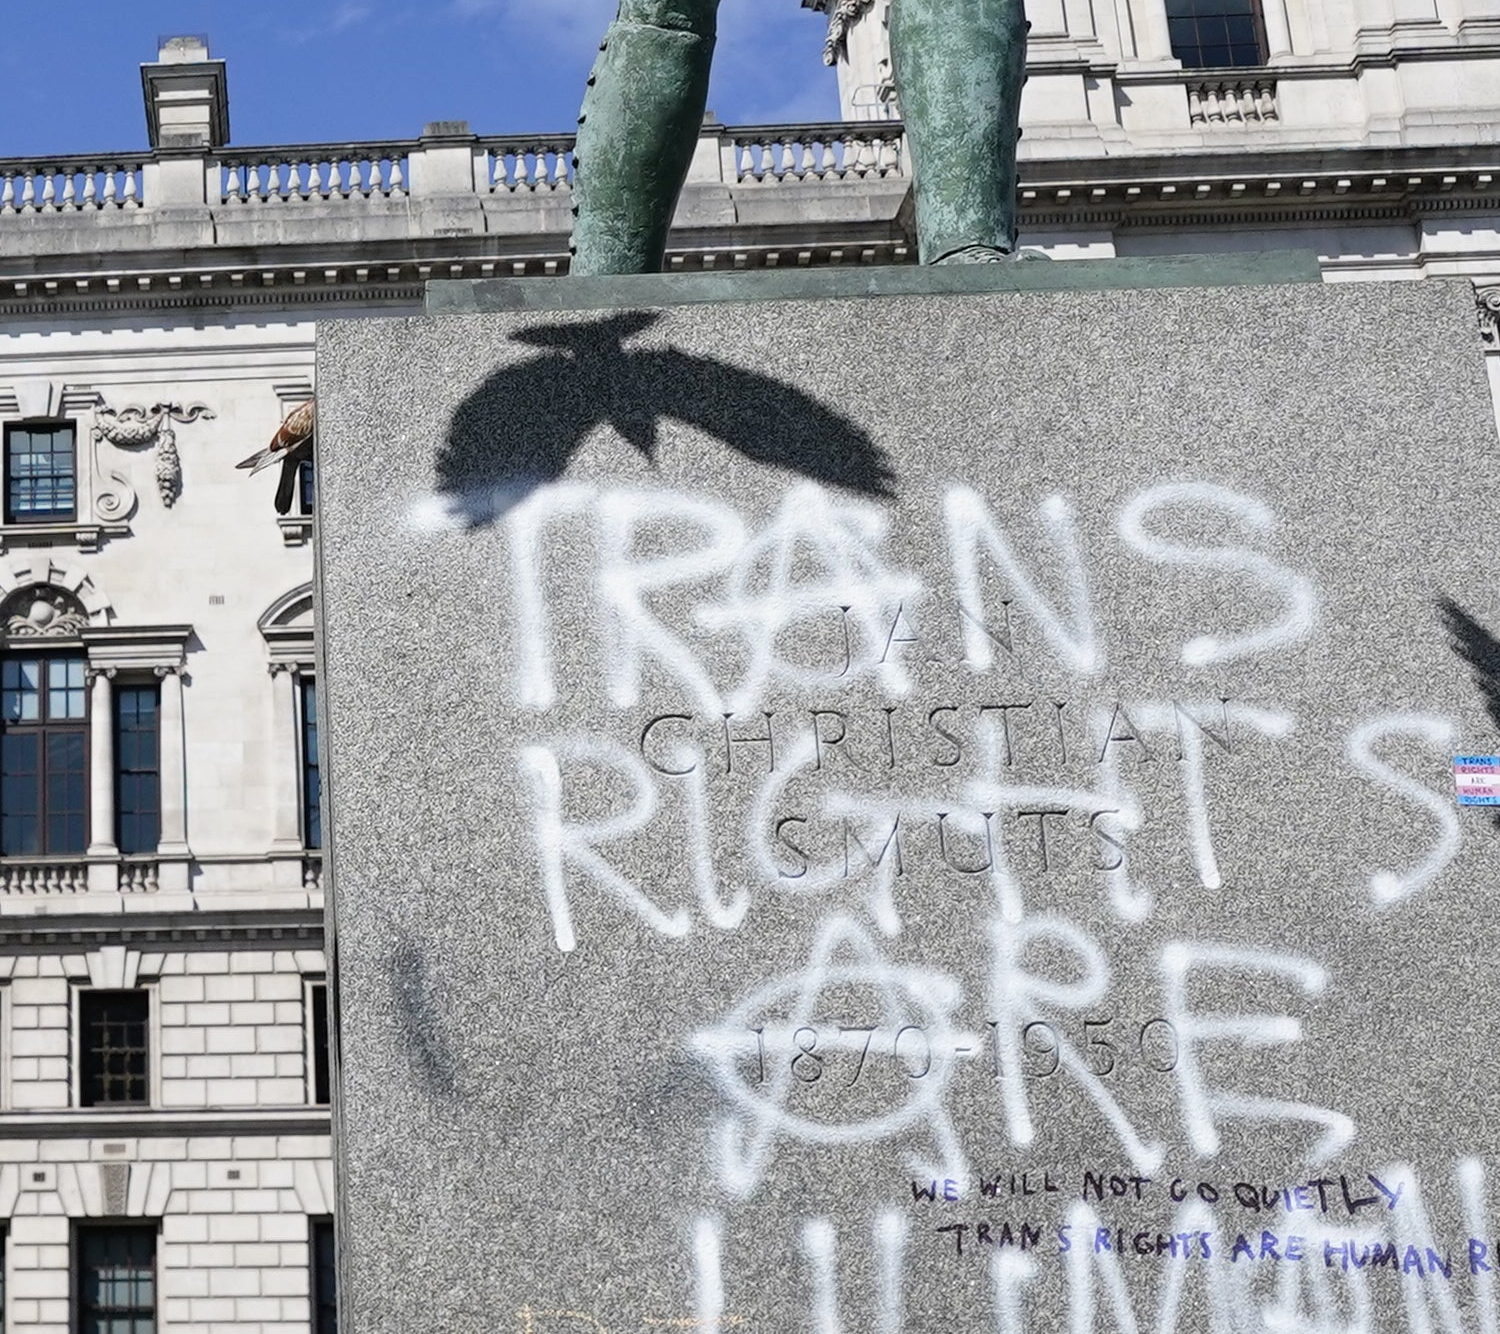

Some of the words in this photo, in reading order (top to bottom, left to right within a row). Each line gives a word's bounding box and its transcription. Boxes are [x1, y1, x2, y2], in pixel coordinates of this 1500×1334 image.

[408, 478, 1317, 718] TRANS
[838, 600, 1015, 677] JAN
[641, 697, 1234, 774] CHRISTIAN
[1461, 756, 1493, 766] TRANS
[518, 701, 1462, 951] RIGHTS
[776, 809, 1125, 879] SMUTS
[690, 909, 1356, 1198] ARE
[750, 1018, 1180, 1086] 1870-1950
[911, 1179, 959, 1201] WE
[979, 1173, 1060, 1198] WILL
[1082, 1170, 1152, 1200] NOT
[1233, 1174, 1405, 1214] QUIETLY
[937, 1222, 1072, 1255] TRANS
[1094, 1227, 1212, 1260] RIGHTS
[1231, 1230, 1304, 1262] ARE
[1323, 1239, 1452, 1279] HUMAN
